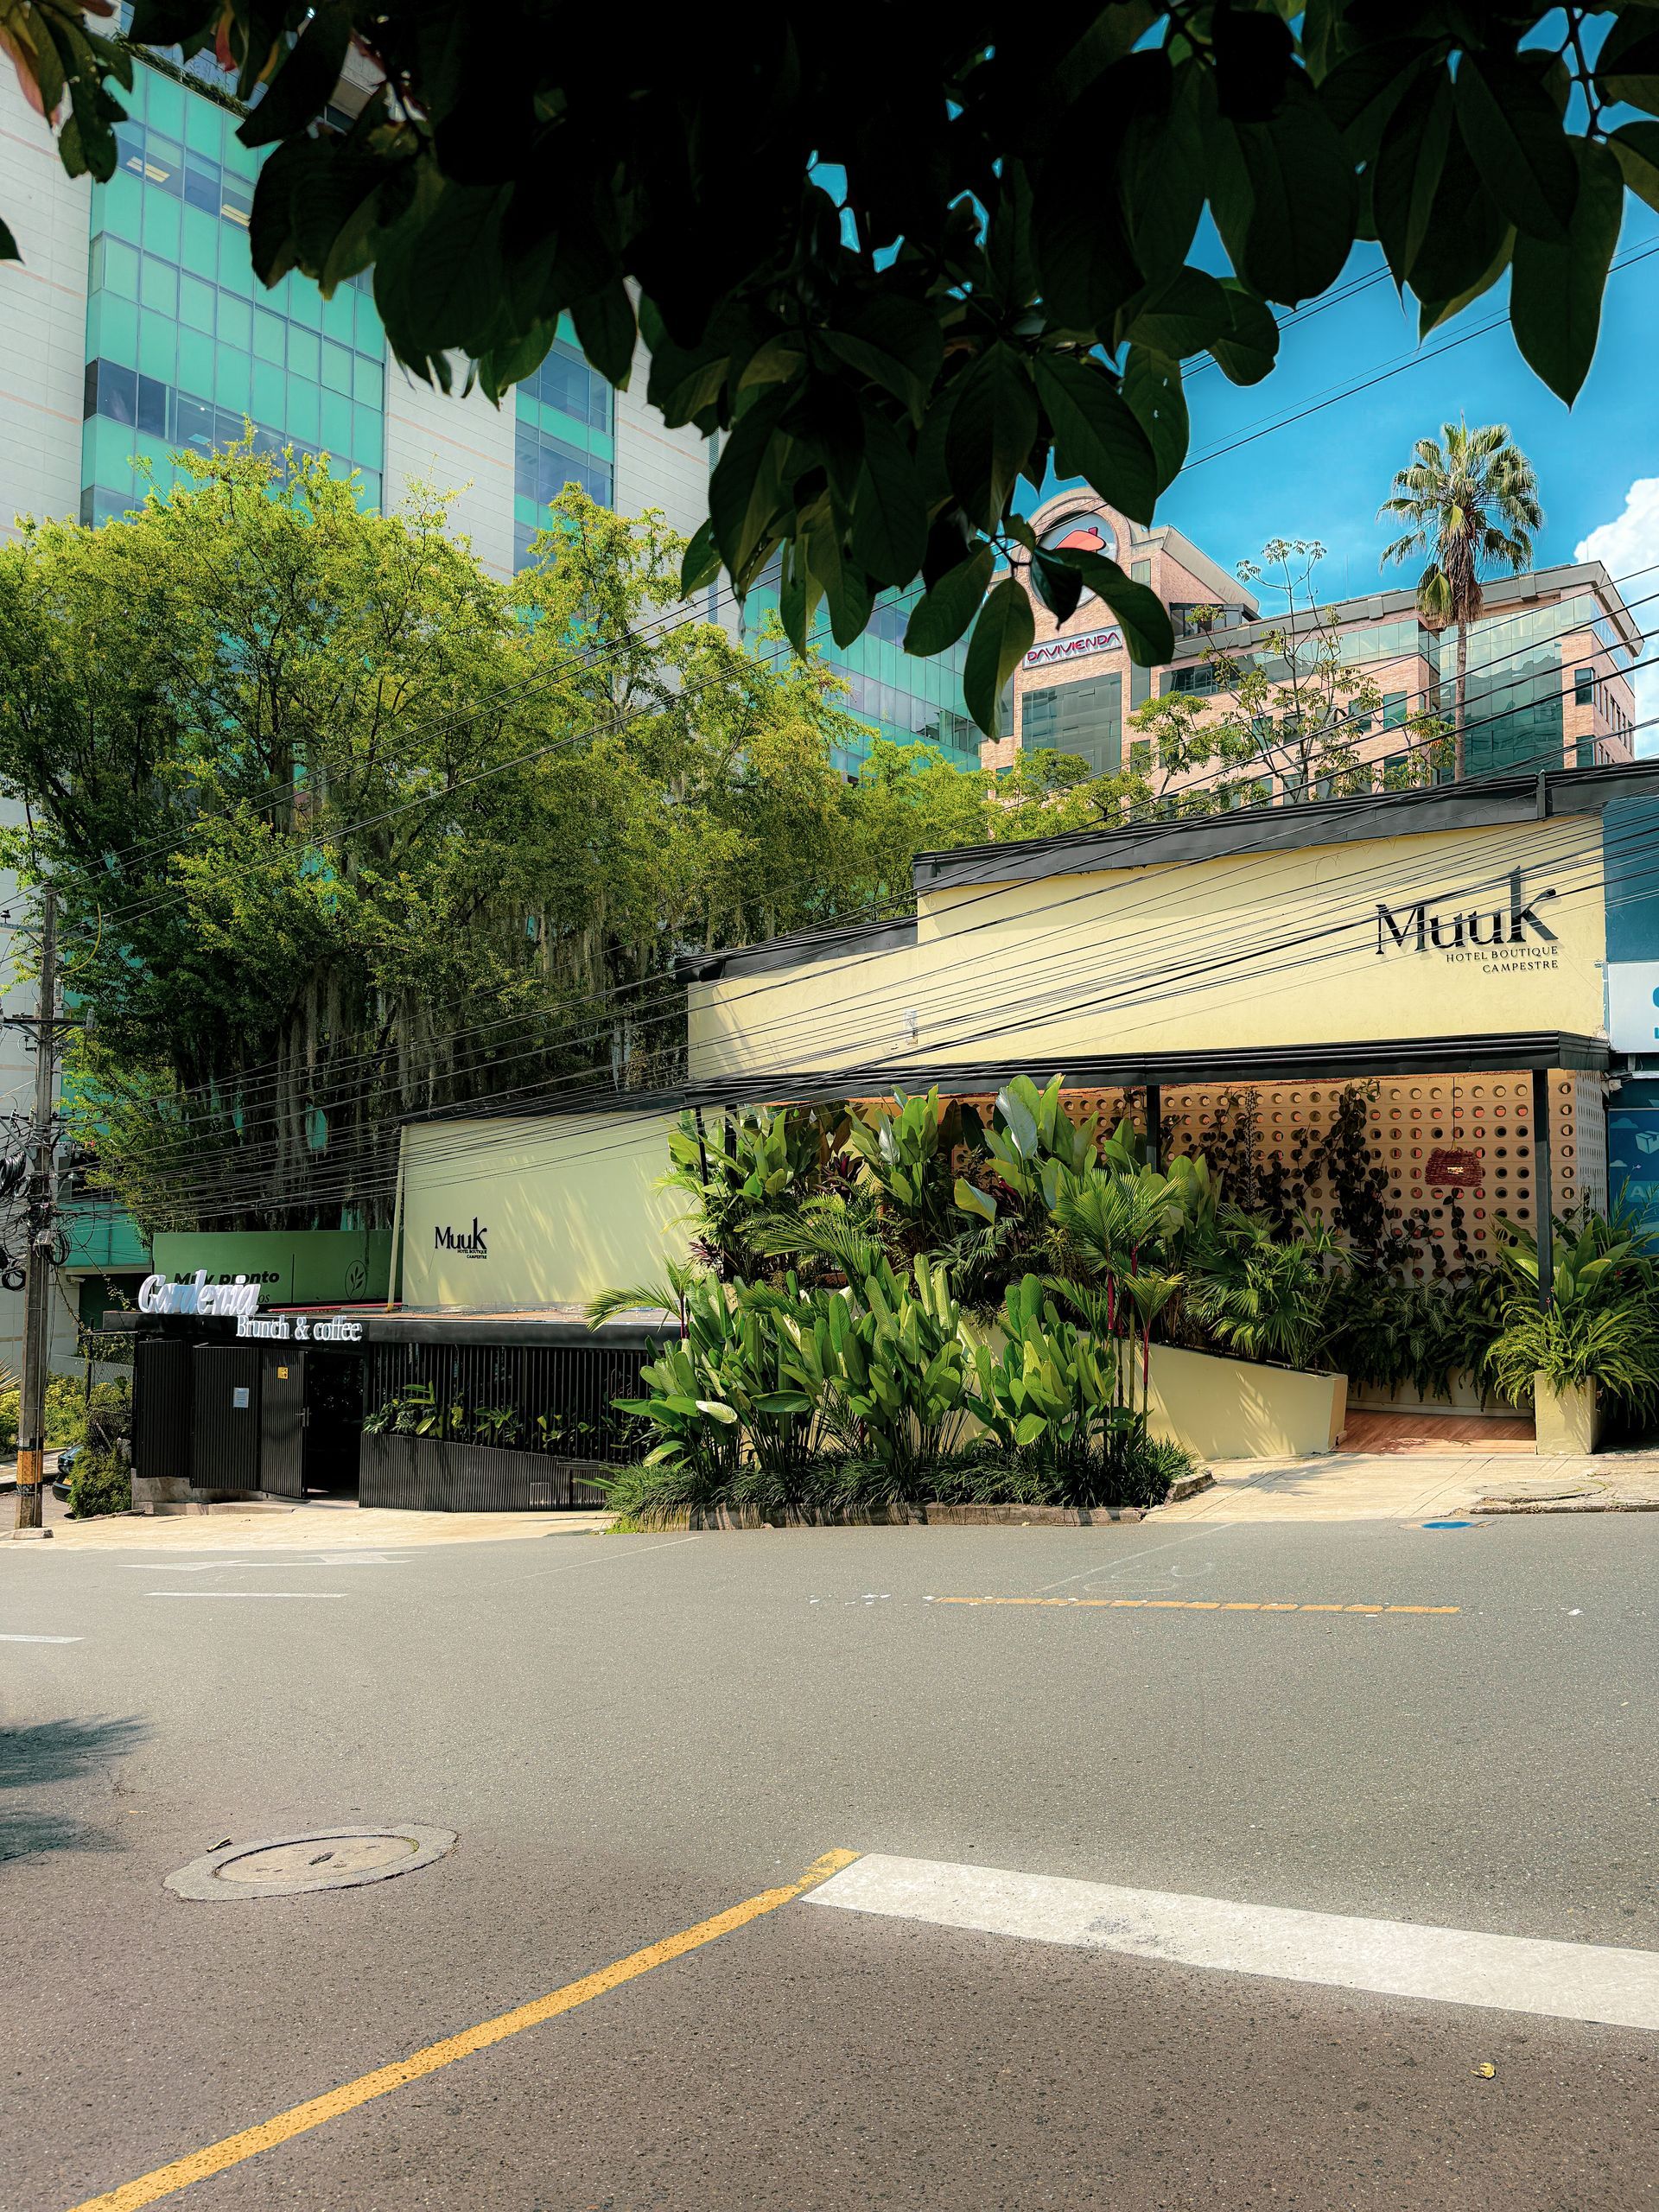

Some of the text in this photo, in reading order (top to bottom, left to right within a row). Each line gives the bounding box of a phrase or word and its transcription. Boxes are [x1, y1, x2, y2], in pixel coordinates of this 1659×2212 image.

[1027, 632, 1122, 662] DAVIVIENDA
[1375, 865, 1560, 955] Muuk
[1446, 945, 1559, 963] HOTEL BOUTIQUE
[1482, 959, 1559, 973] CAMPESTRE
[435, 1217, 487, 1250] Muuk
[138, 1269, 261, 1316] Gardenia
[236, 1314, 363, 1341] Brunch & coffee
